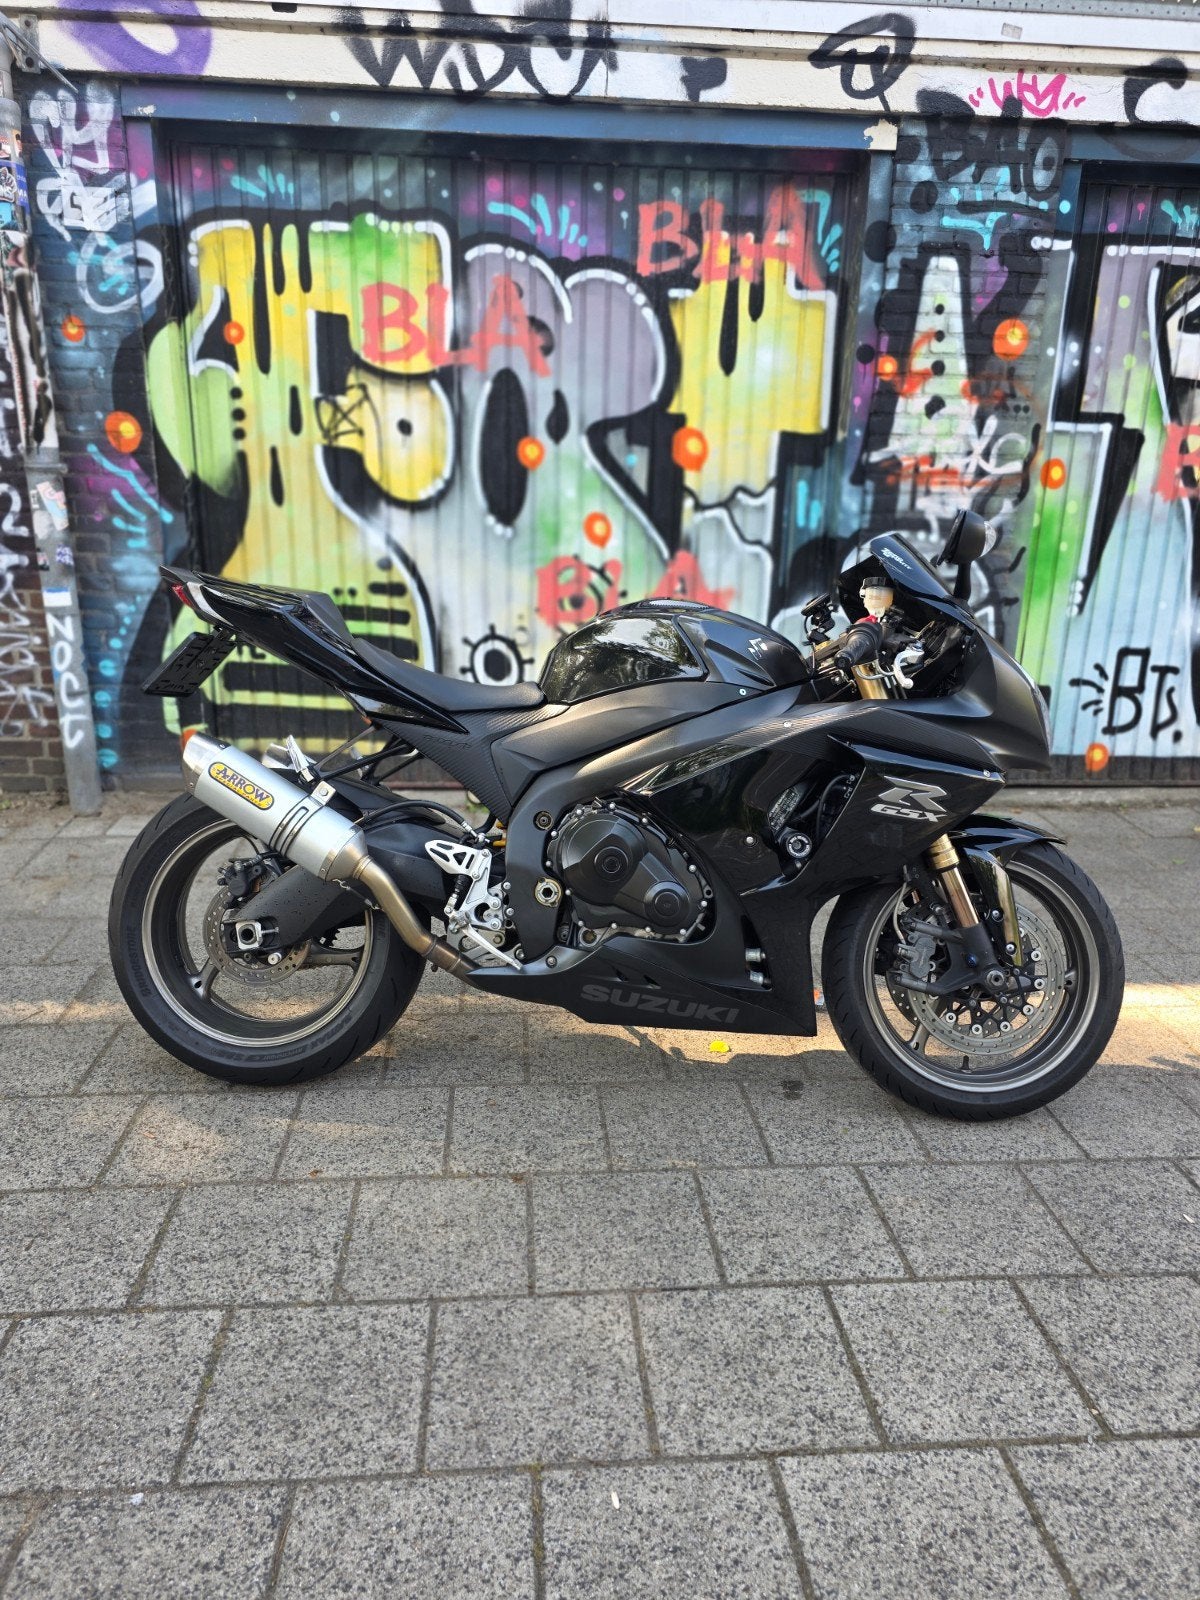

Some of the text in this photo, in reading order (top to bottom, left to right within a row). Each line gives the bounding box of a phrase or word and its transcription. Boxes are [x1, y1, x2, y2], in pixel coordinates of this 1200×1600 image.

[636, 181, 827, 292] BLA
[361, 272, 553, 379] BLA
[215, 766, 271, 803] ARROW
[870, 803, 948, 823] GSX
[580, 984, 740, 1024] SUZUKI
